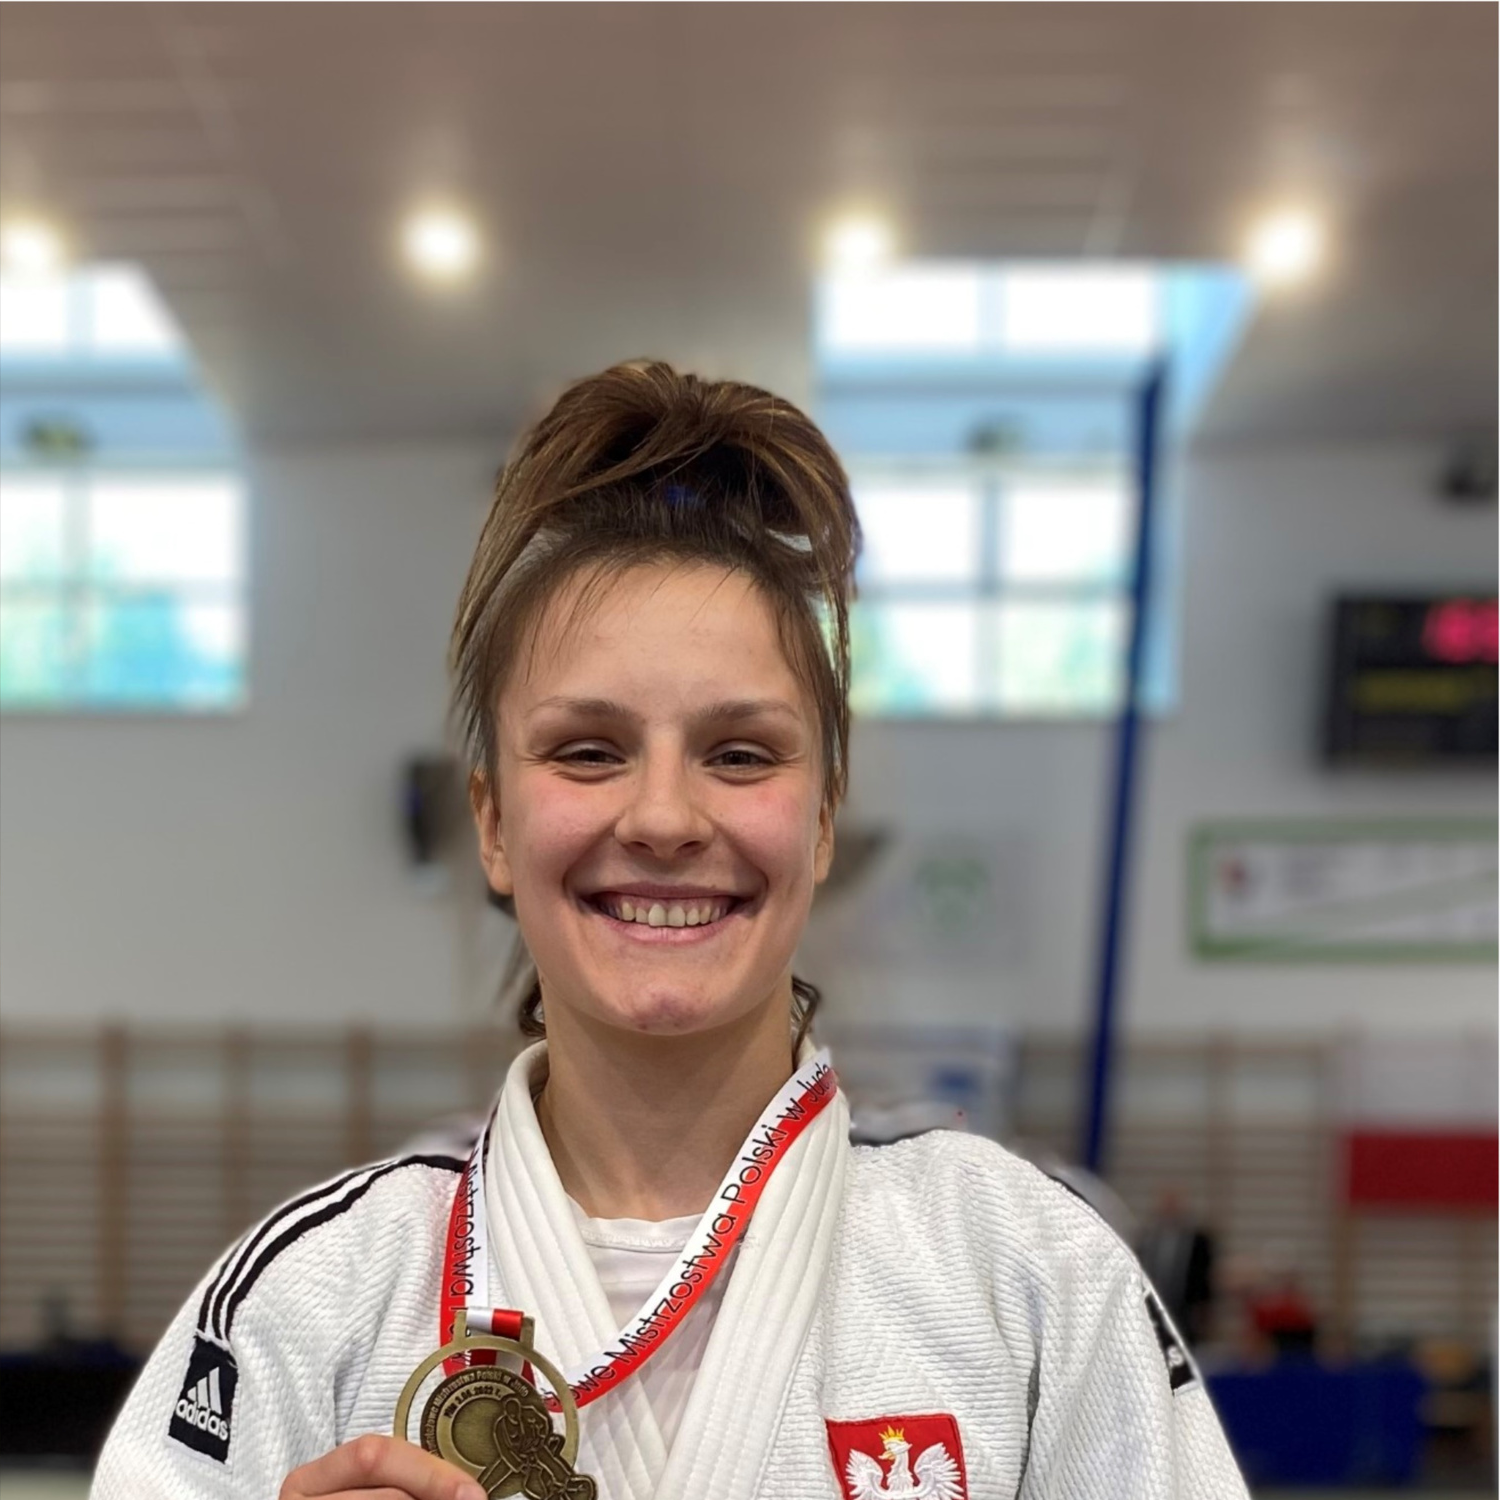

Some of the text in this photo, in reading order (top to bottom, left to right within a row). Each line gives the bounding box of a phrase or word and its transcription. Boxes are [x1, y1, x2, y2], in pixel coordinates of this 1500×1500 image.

[603, 1212, 738, 1364] Mistrzostwa
[720, 1123, 787, 1204] Polski
[776, 1097, 807, 1122] w
[175, 1398, 229, 1441] adidas
